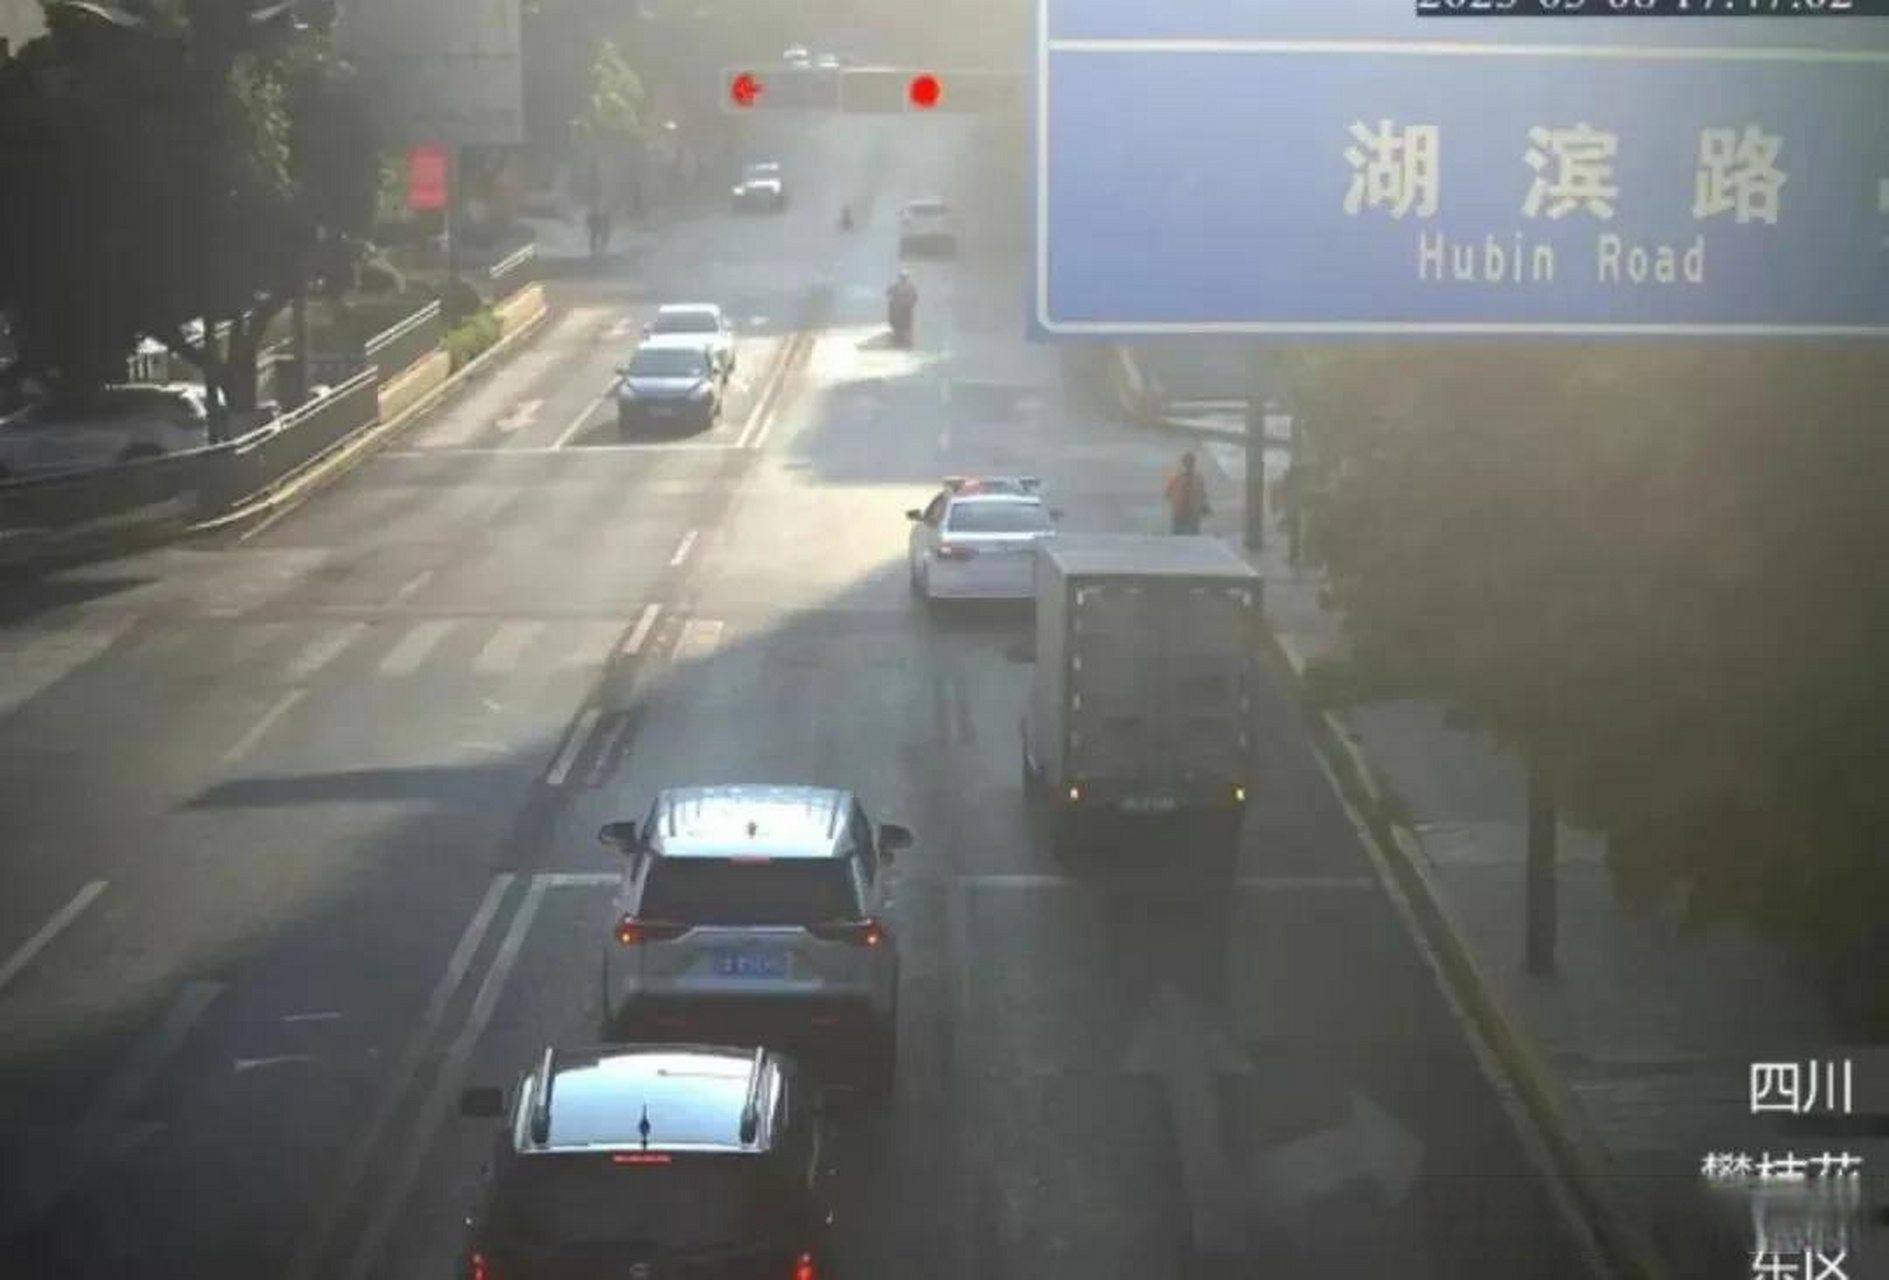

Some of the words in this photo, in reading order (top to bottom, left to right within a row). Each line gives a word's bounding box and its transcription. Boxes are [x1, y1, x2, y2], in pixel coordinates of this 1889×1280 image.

[1342, 119, 1788, 224] 湖滨路
[1417, 232, 1555, 284] Hubin
[1598, 234, 1706, 284] Road
